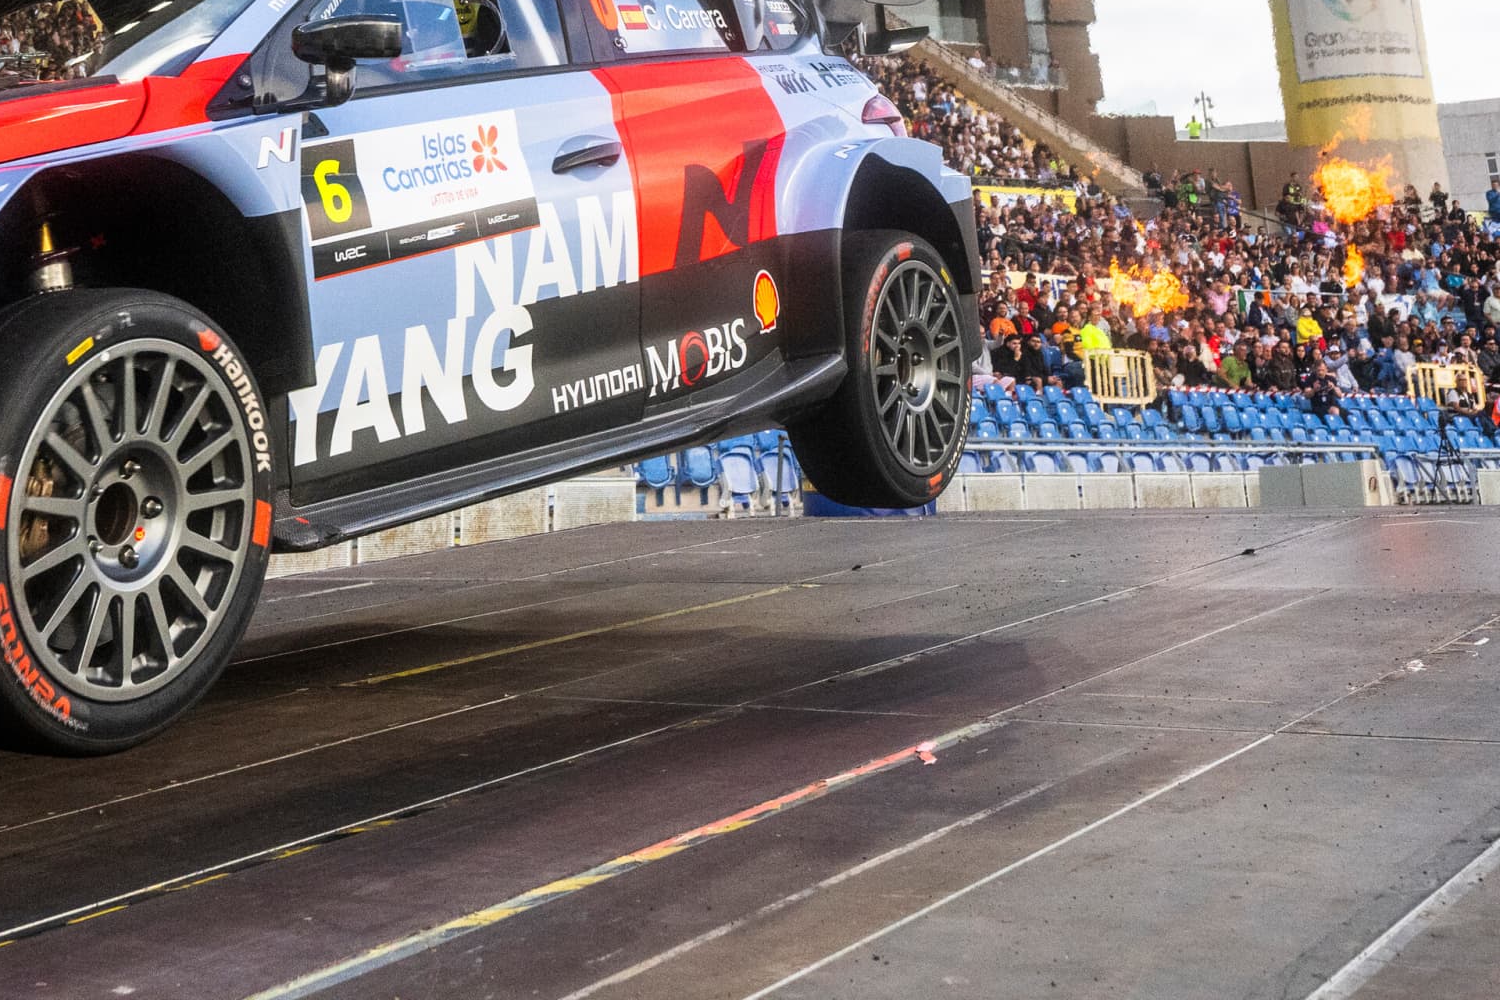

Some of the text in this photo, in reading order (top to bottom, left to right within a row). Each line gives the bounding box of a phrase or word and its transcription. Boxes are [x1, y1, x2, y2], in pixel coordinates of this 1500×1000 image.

[643, 3, 728, 31] C. Carrera
[257, 127, 297, 170] N
[422, 132, 466, 161] Islas
[313, 159, 353, 224] 6
[382, 155, 473, 193] Canarias
[487, 213, 520, 225] WRC.com
[334, 245, 367, 263] WRC
[454, 190, 640, 320] NAM
[288, 303, 536, 467] YANG
[551, 318, 747, 414] HYUNDAI MOBIS
